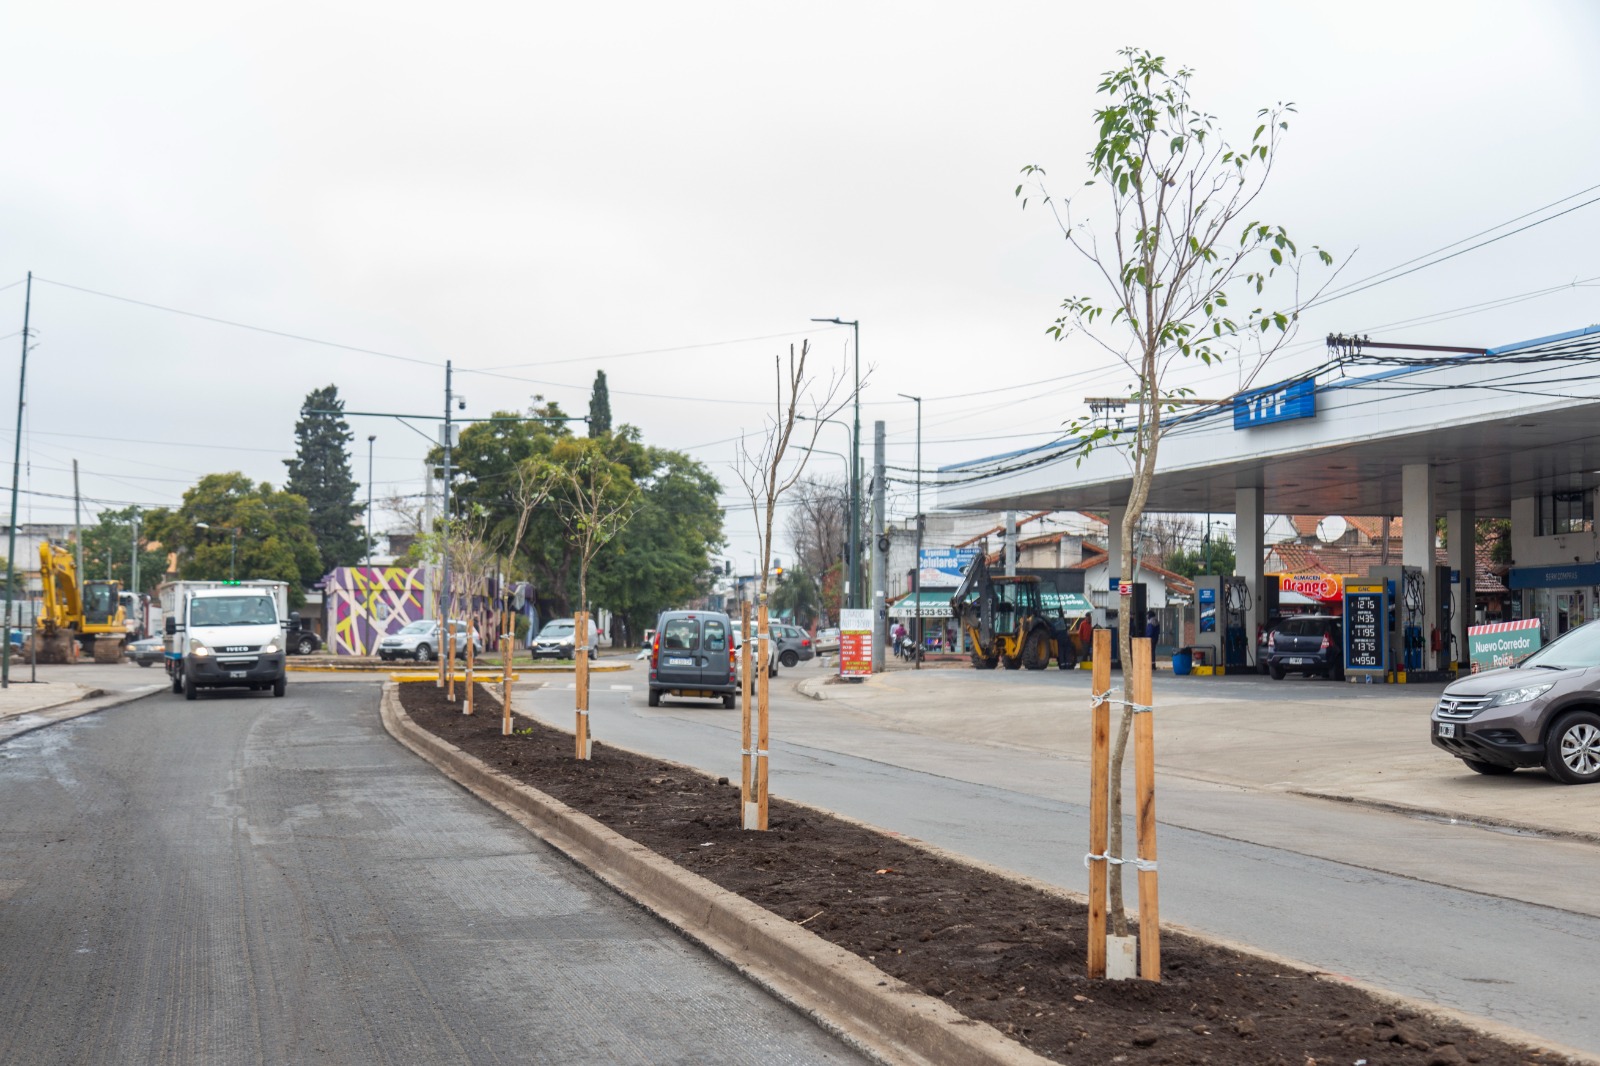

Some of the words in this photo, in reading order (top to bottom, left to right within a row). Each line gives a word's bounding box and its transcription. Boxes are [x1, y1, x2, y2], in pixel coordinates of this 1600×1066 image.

[1246, 389, 1287, 420] YPF
[920, 556, 958, 569] Celulares
[1283, 578, 1328, 596] Orange
[1357, 601, 1374, 609] 1215
[1357, 614, 1374, 622] 1435
[1357, 628, 1374, 636] 1195
[1475, 641, 1497, 653] Nuevo
[1498, 637, 1530, 651] Corredor
[1493, 653, 1514, 667] Rolón
